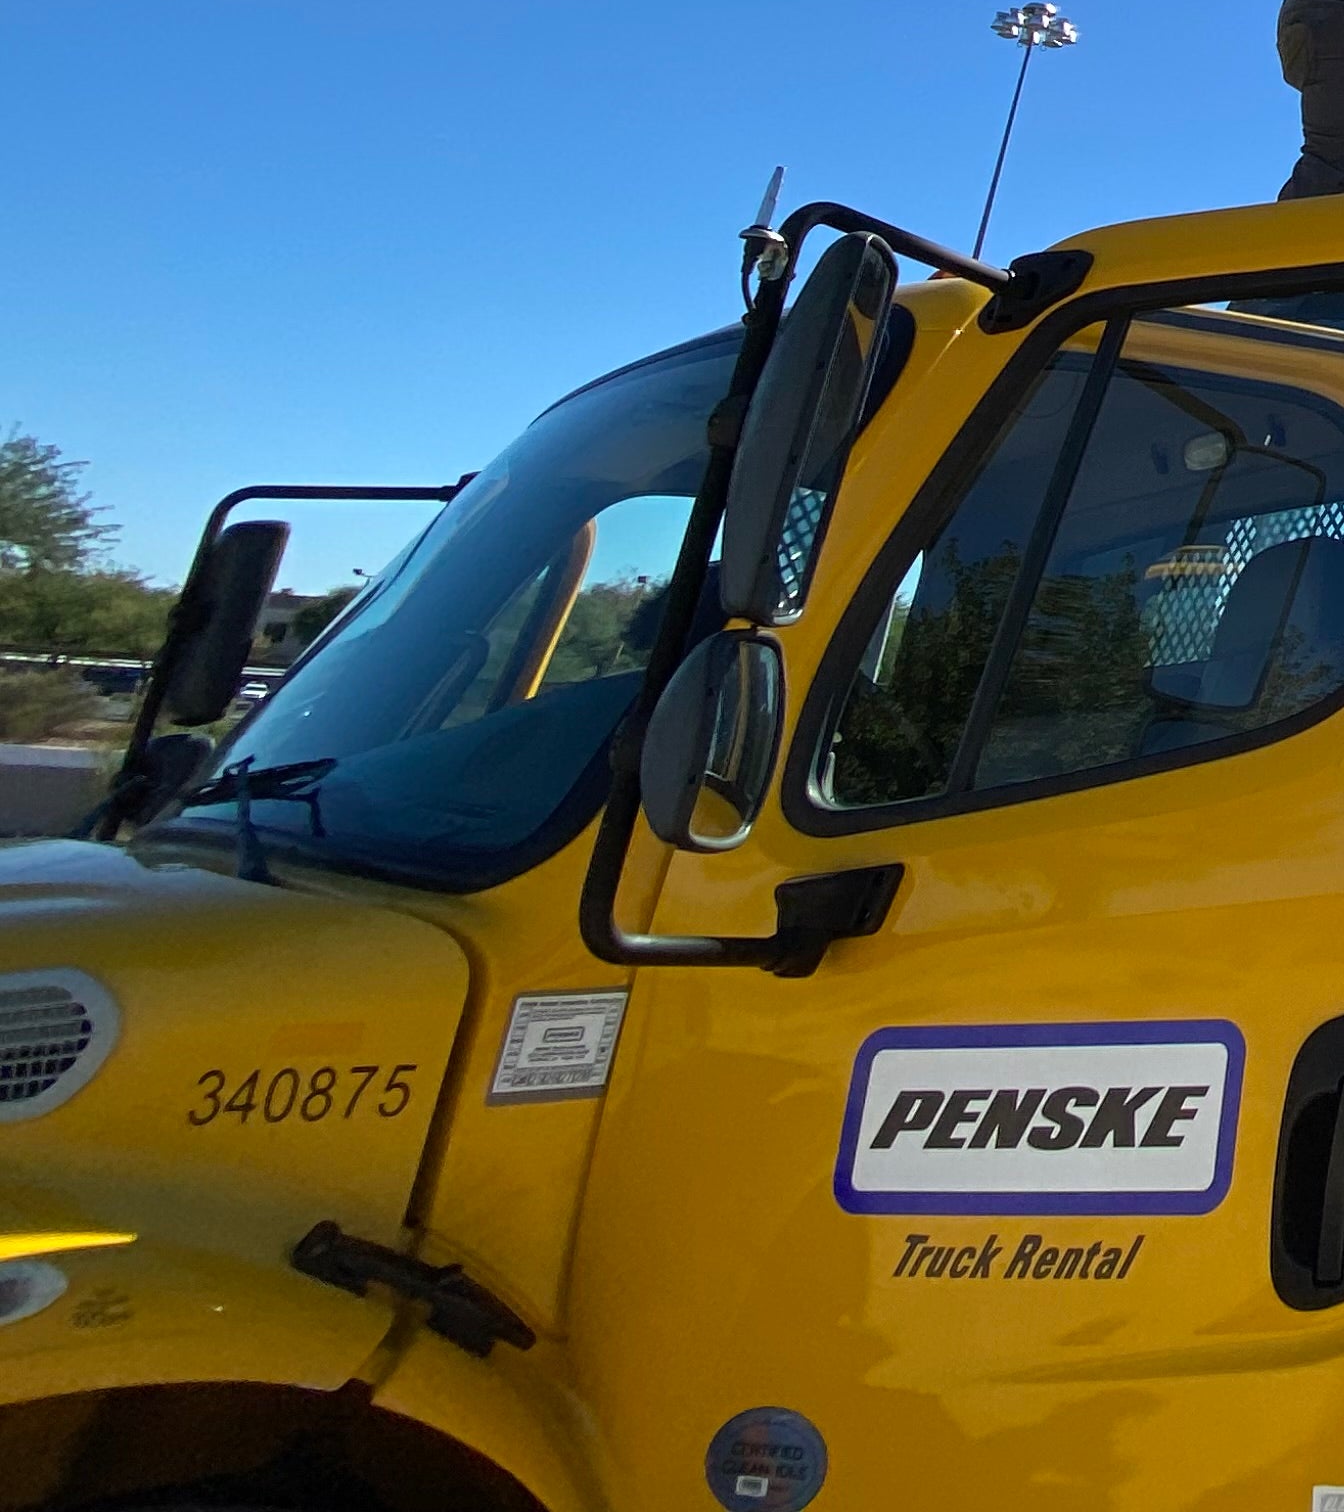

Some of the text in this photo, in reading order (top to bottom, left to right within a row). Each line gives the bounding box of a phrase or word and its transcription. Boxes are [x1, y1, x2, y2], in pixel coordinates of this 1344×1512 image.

[190, 1064, 417, 1126] 340875
[869, 1085, 1210, 1150] PENSKE
[893, 1234, 1146, 1279] Truck Rental
